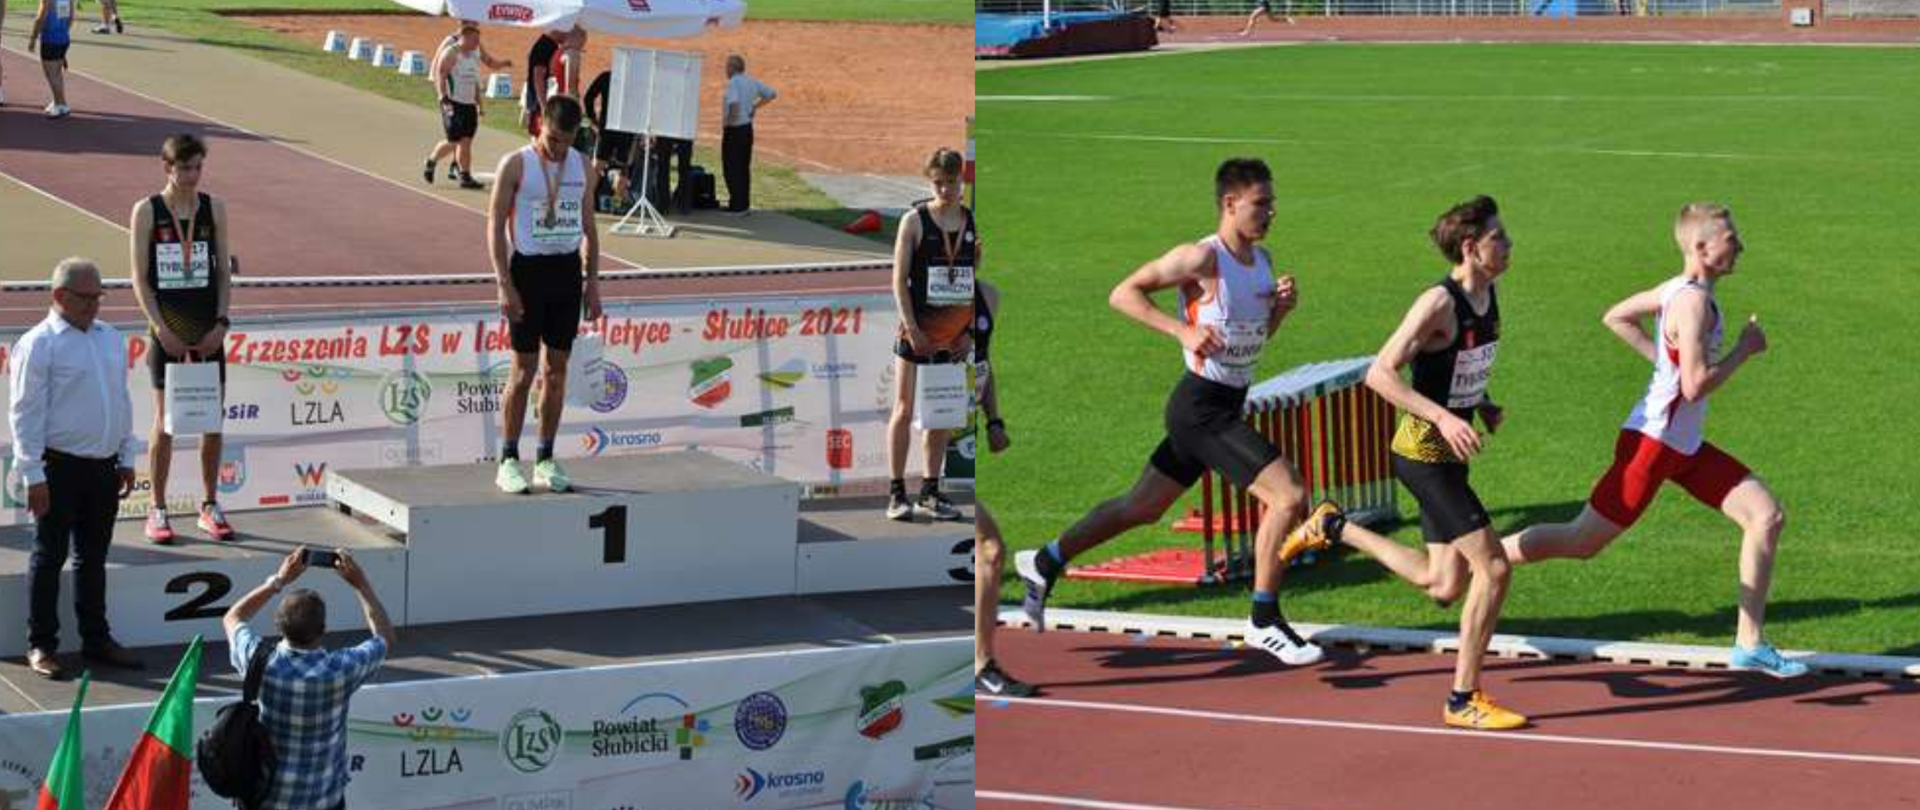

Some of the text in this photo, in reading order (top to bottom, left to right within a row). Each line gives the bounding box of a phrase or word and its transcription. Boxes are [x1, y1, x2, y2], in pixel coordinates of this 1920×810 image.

[226, 326, 368, 365] Zrzeszenia
[378, 322, 430, 356] LZS
[440, 329, 462, 354] w
[701, 308, 788, 340] Słubice
[798, 306, 864, 335] 2021
[291, 401, 344, 425] LZLA
[611, 432, 661, 446] krosno
[589, 505, 627, 563] 1
[164, 572, 231, 620] 2
[592, 716, 657, 737] Powiat
[592, 733, 669, 757] Słubicki
[401, 747, 463, 777] LZLA
[767, 769, 825, 789] krosno
